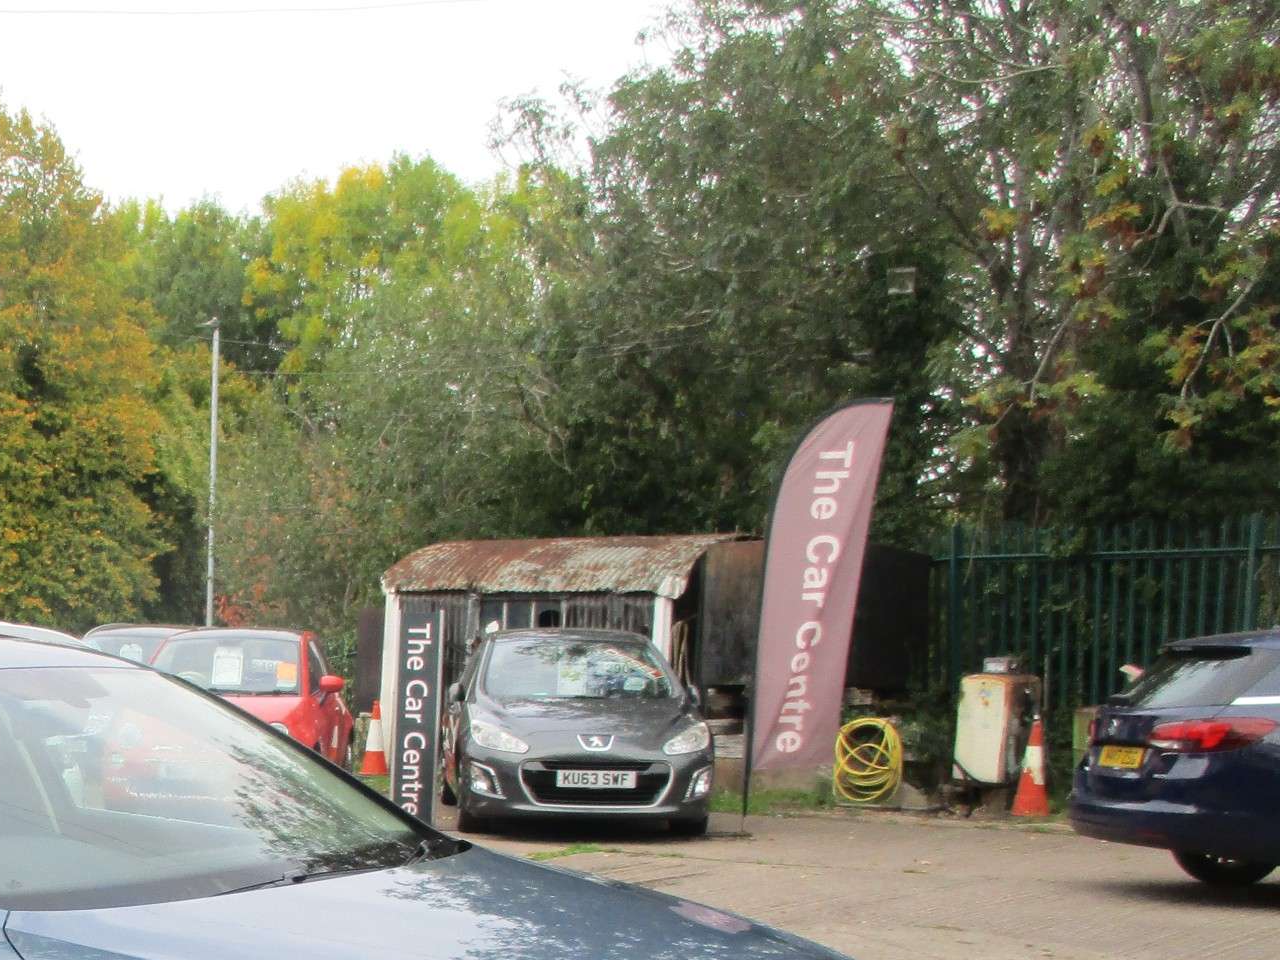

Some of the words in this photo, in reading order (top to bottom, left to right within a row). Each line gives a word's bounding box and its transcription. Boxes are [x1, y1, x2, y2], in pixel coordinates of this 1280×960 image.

[810, 441, 854, 521] The
[801, 535, 841, 610] Car
[406, 622, 432, 671] The
[405, 679, 428, 723] Car
[775, 620, 823, 754] Centre
[401, 732, 426, 817] Centre
[562, 772, 599, 785] KU63
